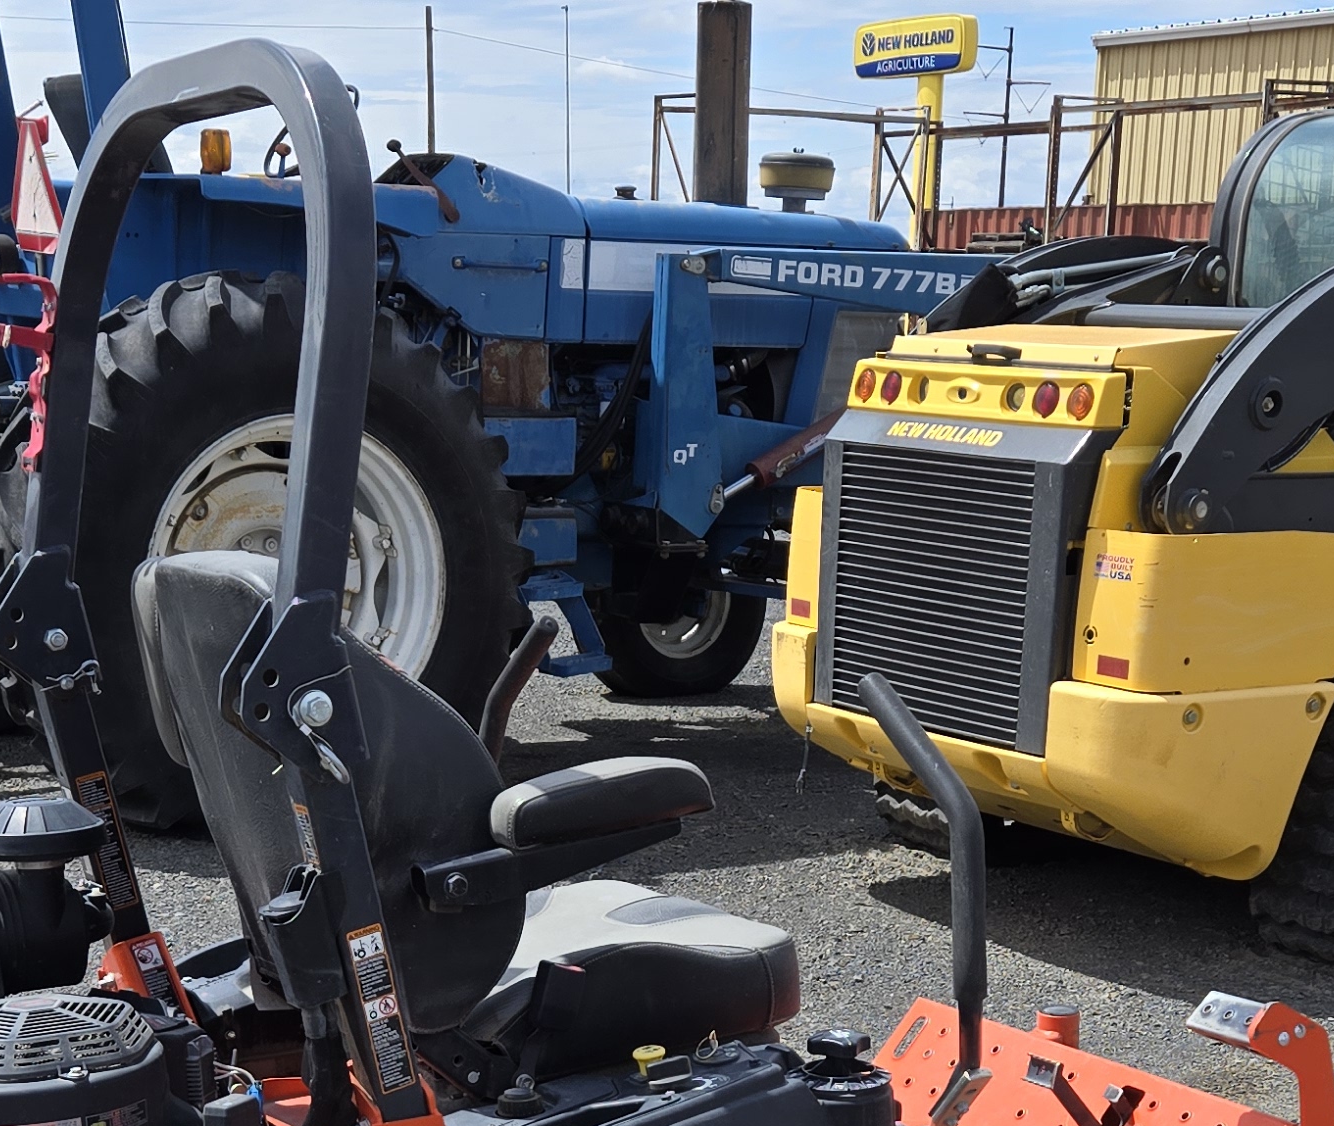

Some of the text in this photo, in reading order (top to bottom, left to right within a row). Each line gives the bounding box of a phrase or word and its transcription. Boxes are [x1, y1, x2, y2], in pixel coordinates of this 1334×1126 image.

[877, 29, 954, 52] NEW HOLLAND
[876, 55, 935, 73] AGRICULTURE
[777, 259, 957, 295] FORD 777B
[887, 421, 1004, 447] NEW HOLLAND
[1097, 553, 1135, 565] PROUDLY
[1110, 562, 1134, 572] BUILT
[1109, 570, 1132, 582] USA
